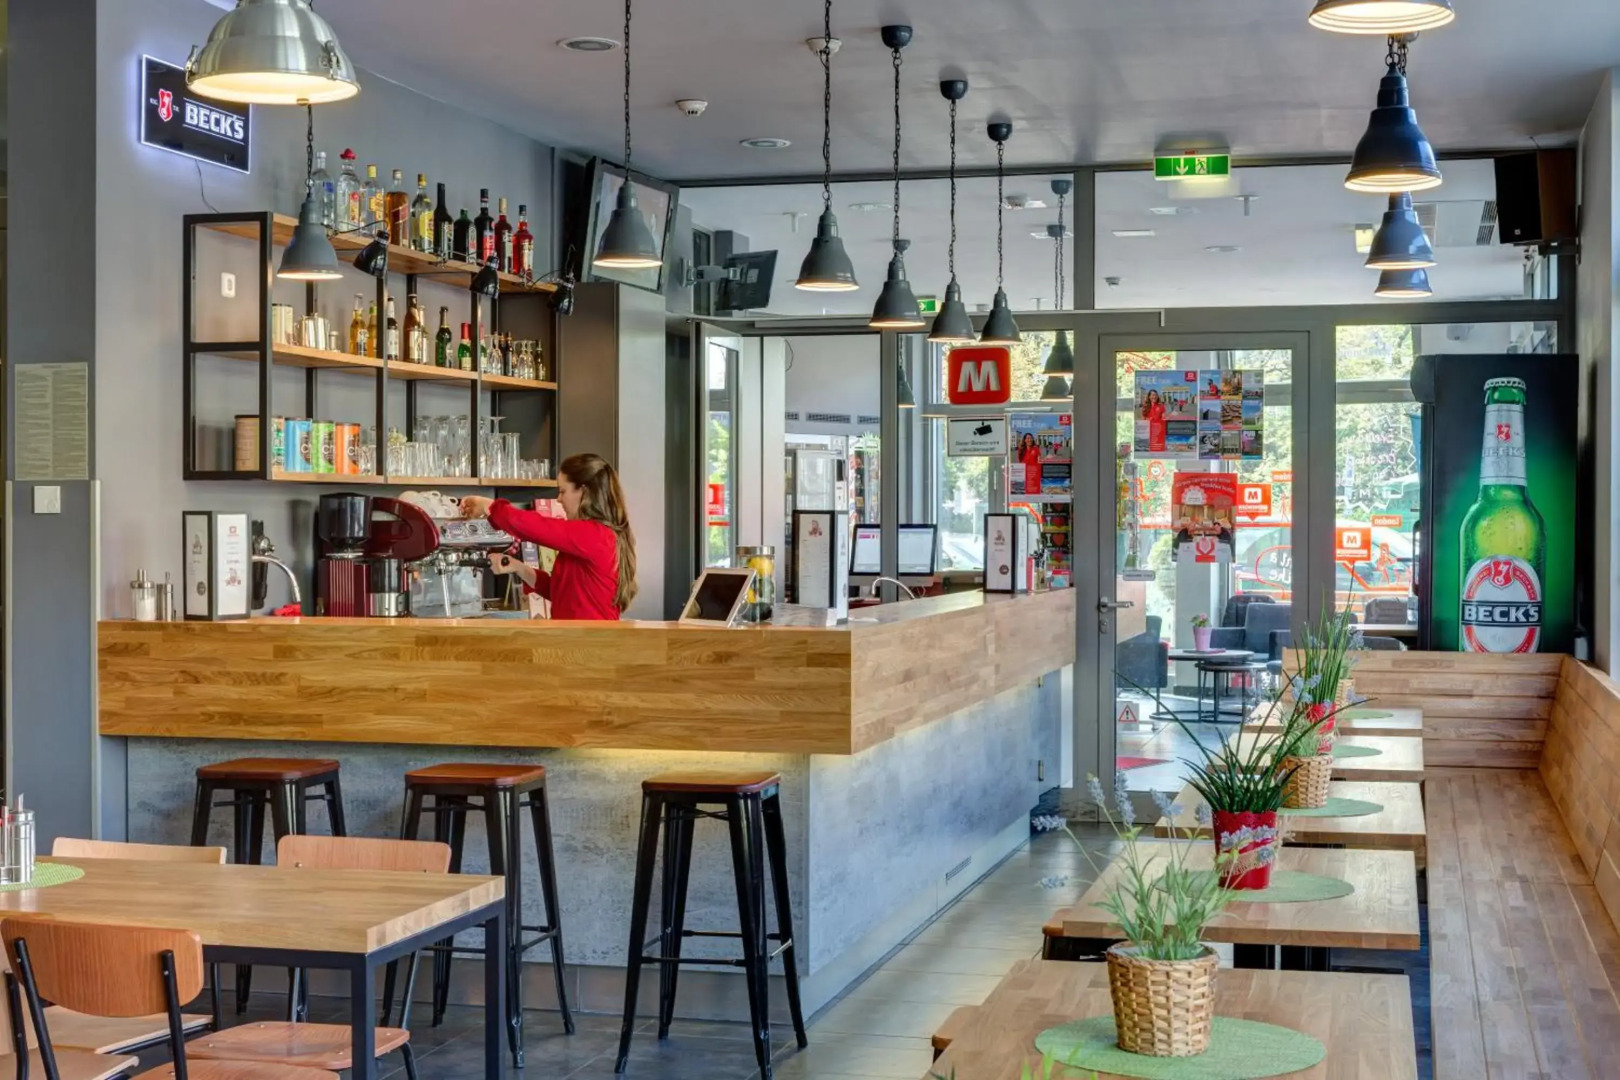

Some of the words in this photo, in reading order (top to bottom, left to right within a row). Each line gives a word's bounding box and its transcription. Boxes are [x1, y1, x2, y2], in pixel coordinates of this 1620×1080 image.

[185, 102, 244, 140] BECK'S
[957, 360, 1001, 393] M
[1011, 419, 1032, 428] FREE
[1463, 604, 1539, 622] BECK'S
